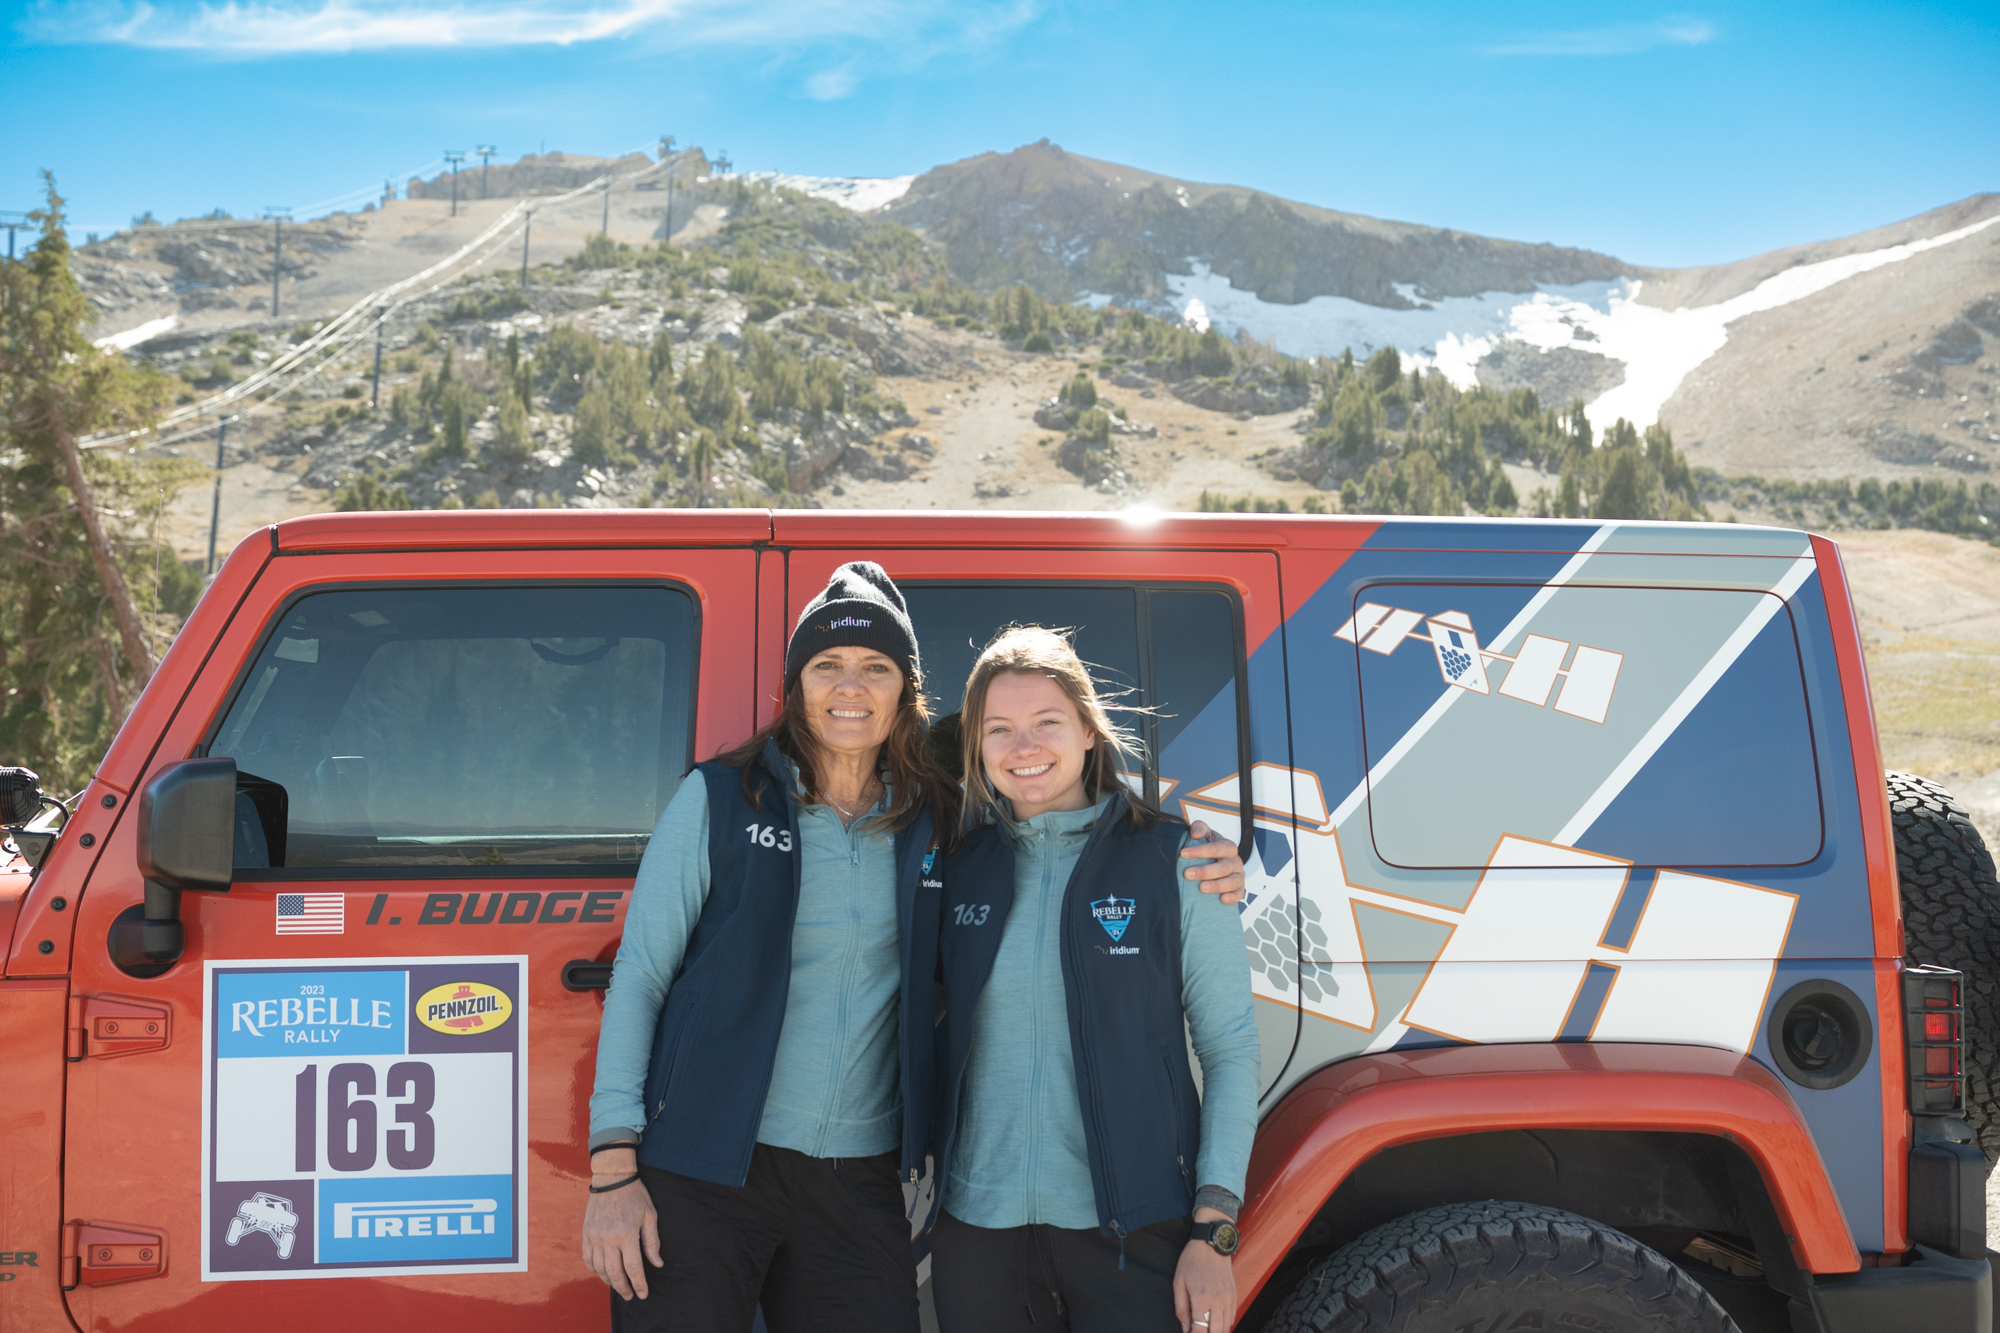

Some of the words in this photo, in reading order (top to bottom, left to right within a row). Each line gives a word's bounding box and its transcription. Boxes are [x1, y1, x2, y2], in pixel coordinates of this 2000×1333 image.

[830, 616, 871, 630] iridium
[745, 823, 793, 852] 163
[417, 891, 624, 925] BUDGE
[953, 903, 991, 926] 163
[1092, 906, 1136, 918] REBELLE
[1109, 946, 1140, 954] iridium
[300, 985, 325, 995] 2023
[231, 996, 392, 1037] REBELLE
[428, 994, 500, 1022] PENNZOIL
[284, 1029, 341, 1044] RALLY
[294, 1061, 436, 1173] 163
[333, 1198, 498, 1239] PIRELLI
